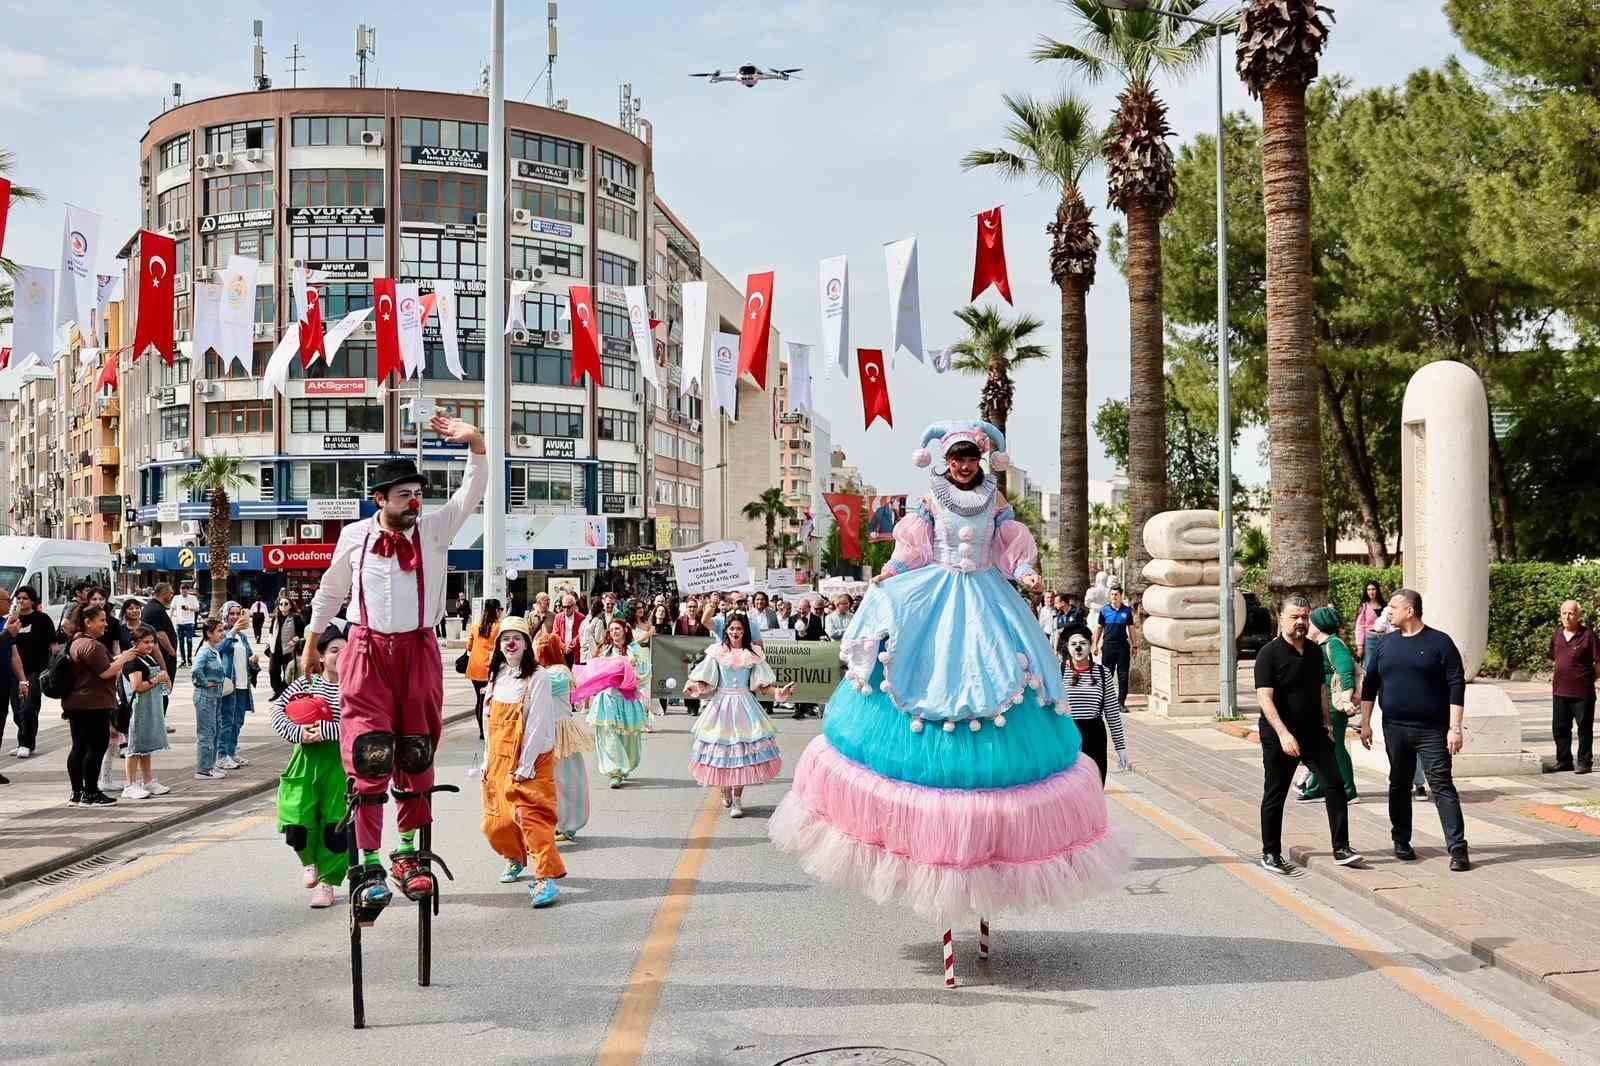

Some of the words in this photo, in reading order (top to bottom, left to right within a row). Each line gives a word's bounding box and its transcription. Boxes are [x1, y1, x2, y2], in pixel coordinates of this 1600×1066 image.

[421, 147, 480, 159] AVUKAT
[535, 166, 562, 177] AVUKAT
[297, 207, 374, 216] AVUKAT
[545, 440, 573, 450] AVUKAT
[198, 552, 248, 563] TUELL
[287, 551, 332, 561] vodafone
[630, 552, 652, 560] GOLD
[774, 667, 831, 683] ESTİVALİ
